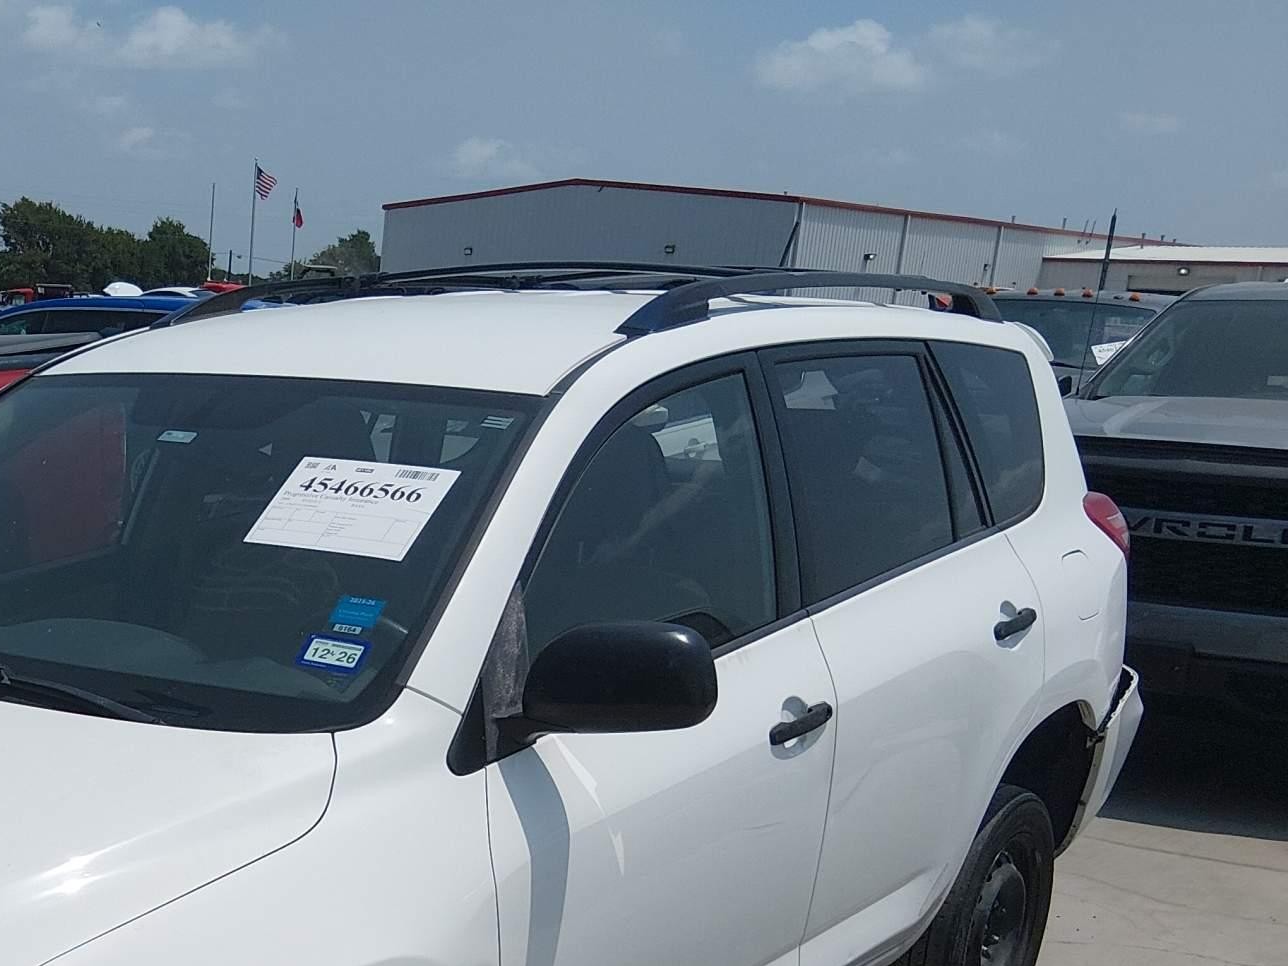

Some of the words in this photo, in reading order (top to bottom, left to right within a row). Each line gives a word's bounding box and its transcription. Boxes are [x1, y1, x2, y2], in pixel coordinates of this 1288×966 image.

[300, 476, 427, 503] 45466566
[1129, 516, 1288, 545] VROL
[312, 646, 331, 660] 12
[336, 651, 358, 664] 26
